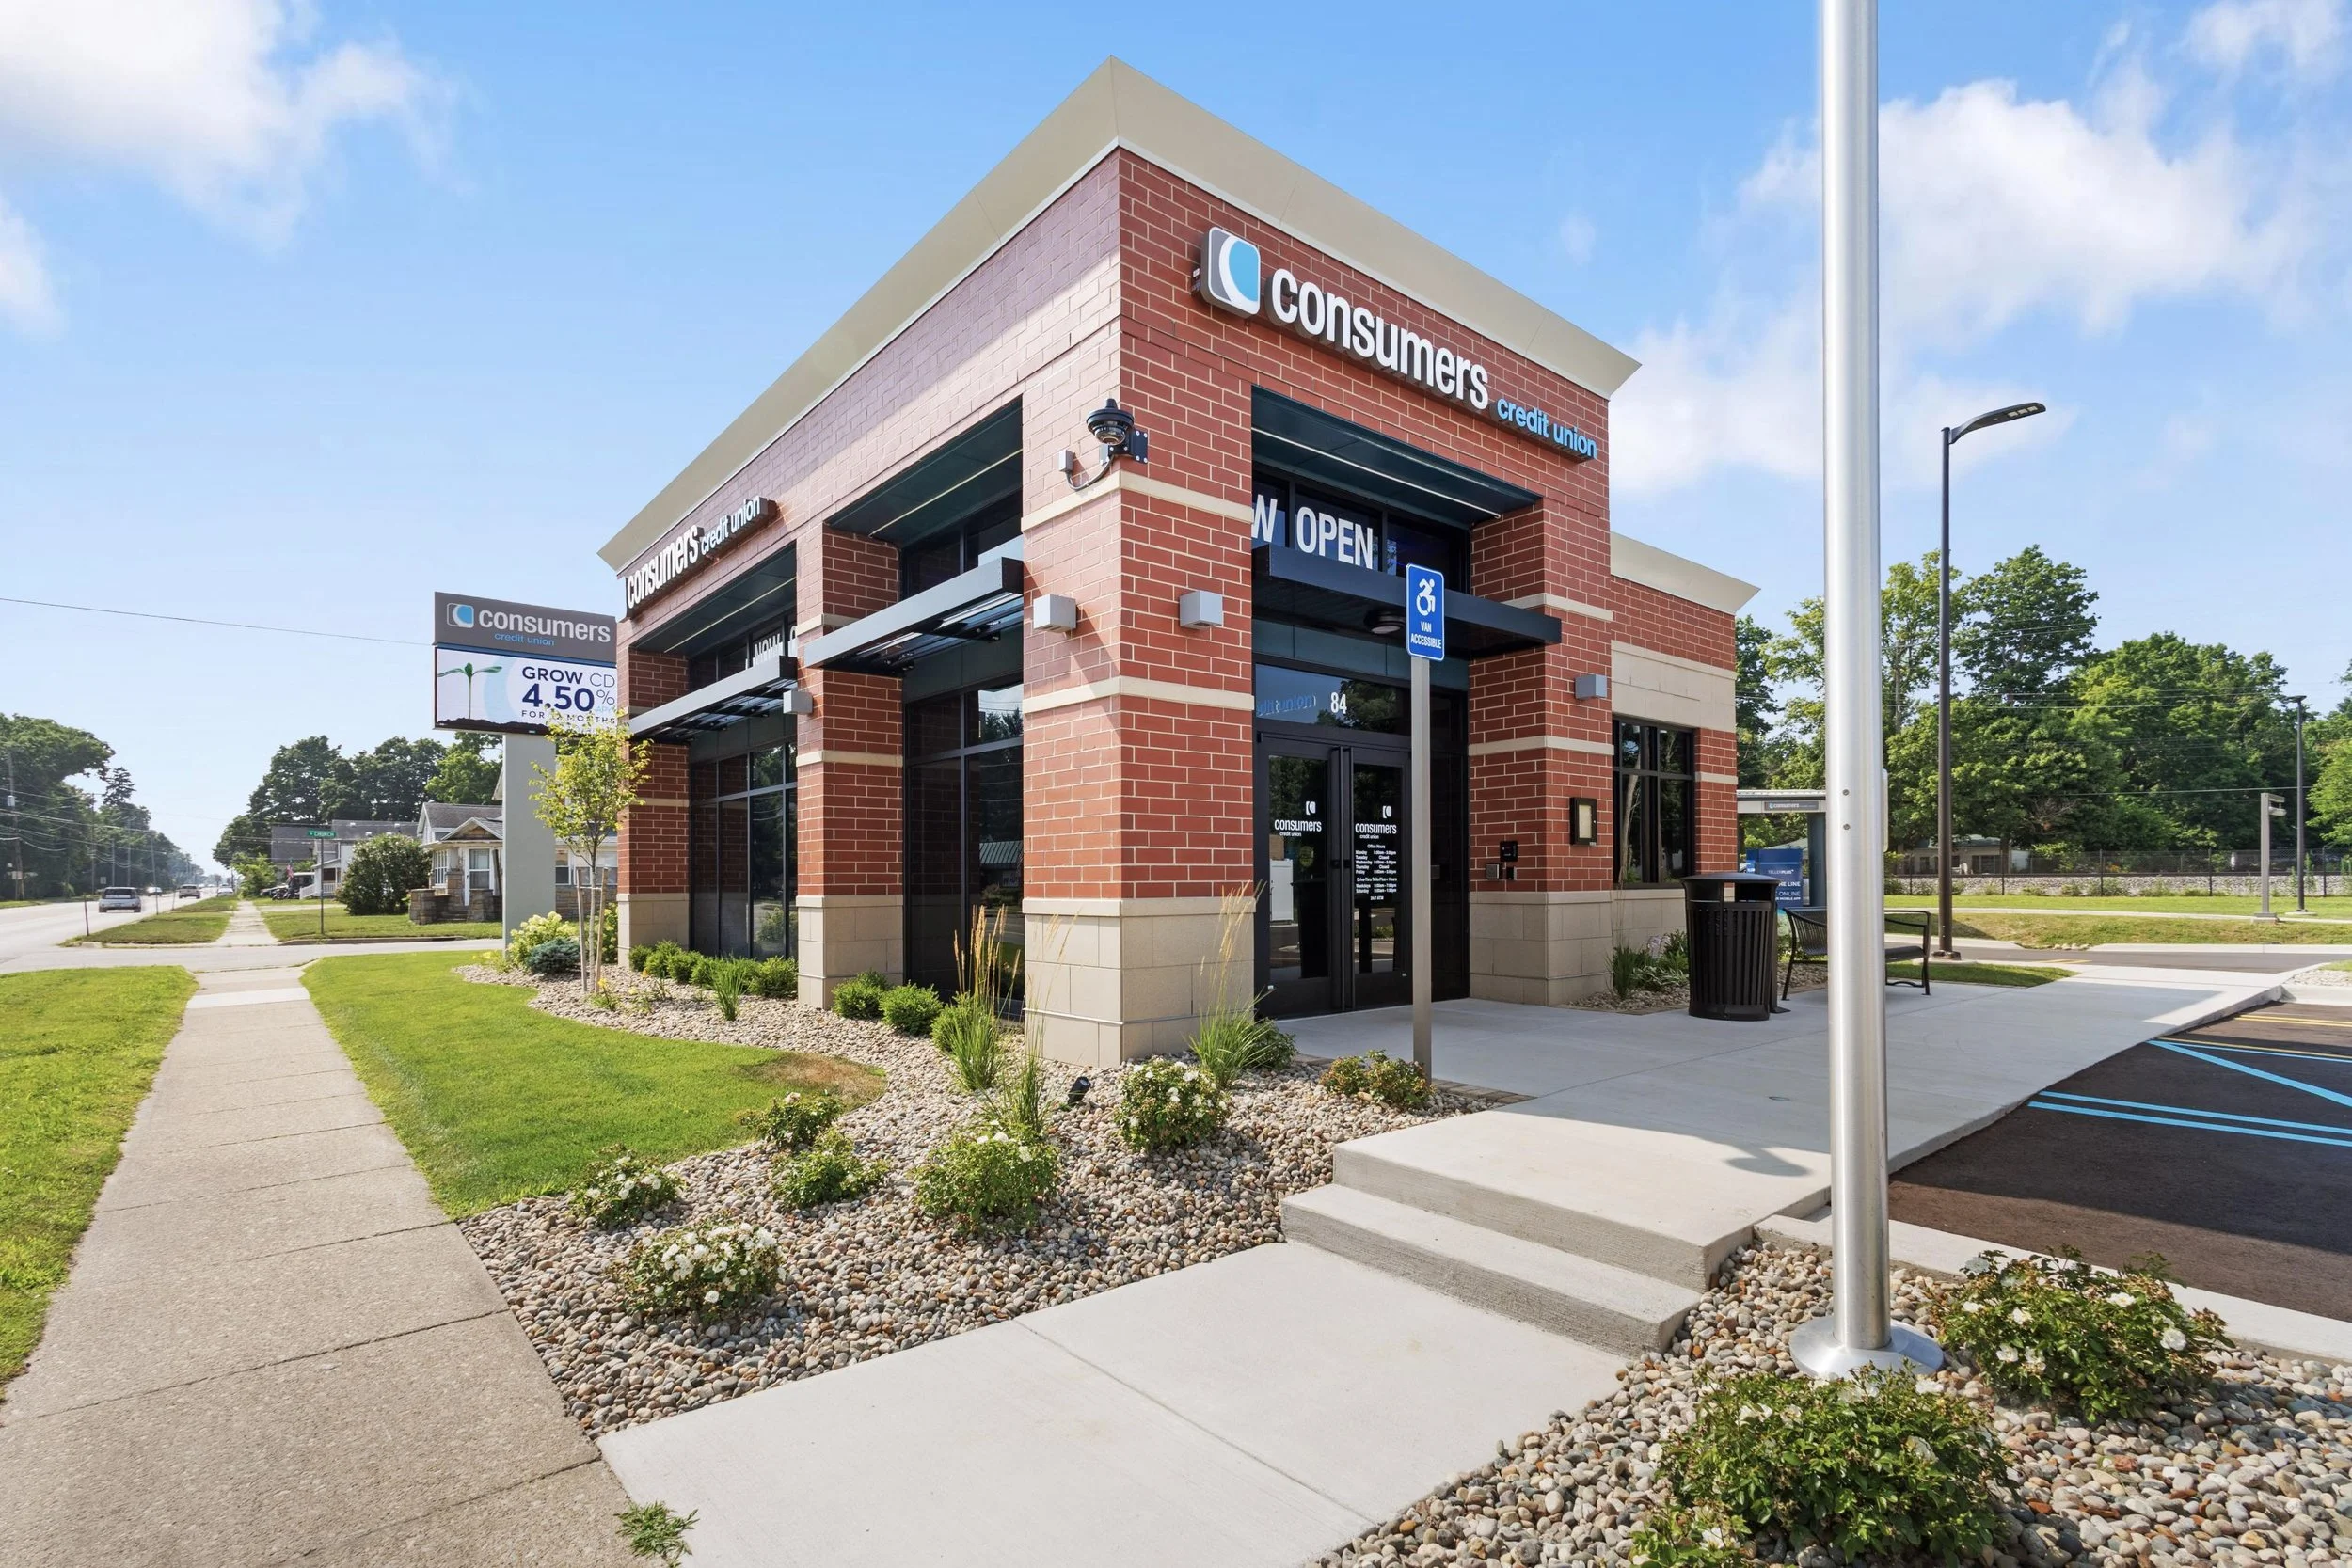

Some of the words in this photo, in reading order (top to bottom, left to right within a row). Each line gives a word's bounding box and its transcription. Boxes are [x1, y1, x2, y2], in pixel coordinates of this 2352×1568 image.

[1271, 268, 1489, 410] consumers
[1497, 398, 1549, 438] credit
[1553, 423, 1597, 460] union
[1296, 506, 1374, 570] OPEN
[627, 524, 699, 609] consumers
[701, 515, 729, 555] credit
[731, 495, 760, 533] union
[479, 610, 611, 643] consumers
[1421, 621, 1432, 632] VAN
[494, 631, 524, 643] credit
[527, 636, 555, 646] union
[1410, 633, 1442, 649] ACCESSIBLE
[522, 666, 583, 685] GROW
[590, 673, 615, 688] CD
[1330, 691, 1347, 714] 84
[521, 710, 545, 719] FOR
[1274, 819, 1322, 832] consumers
[1355, 823, 1397, 834] consumers
